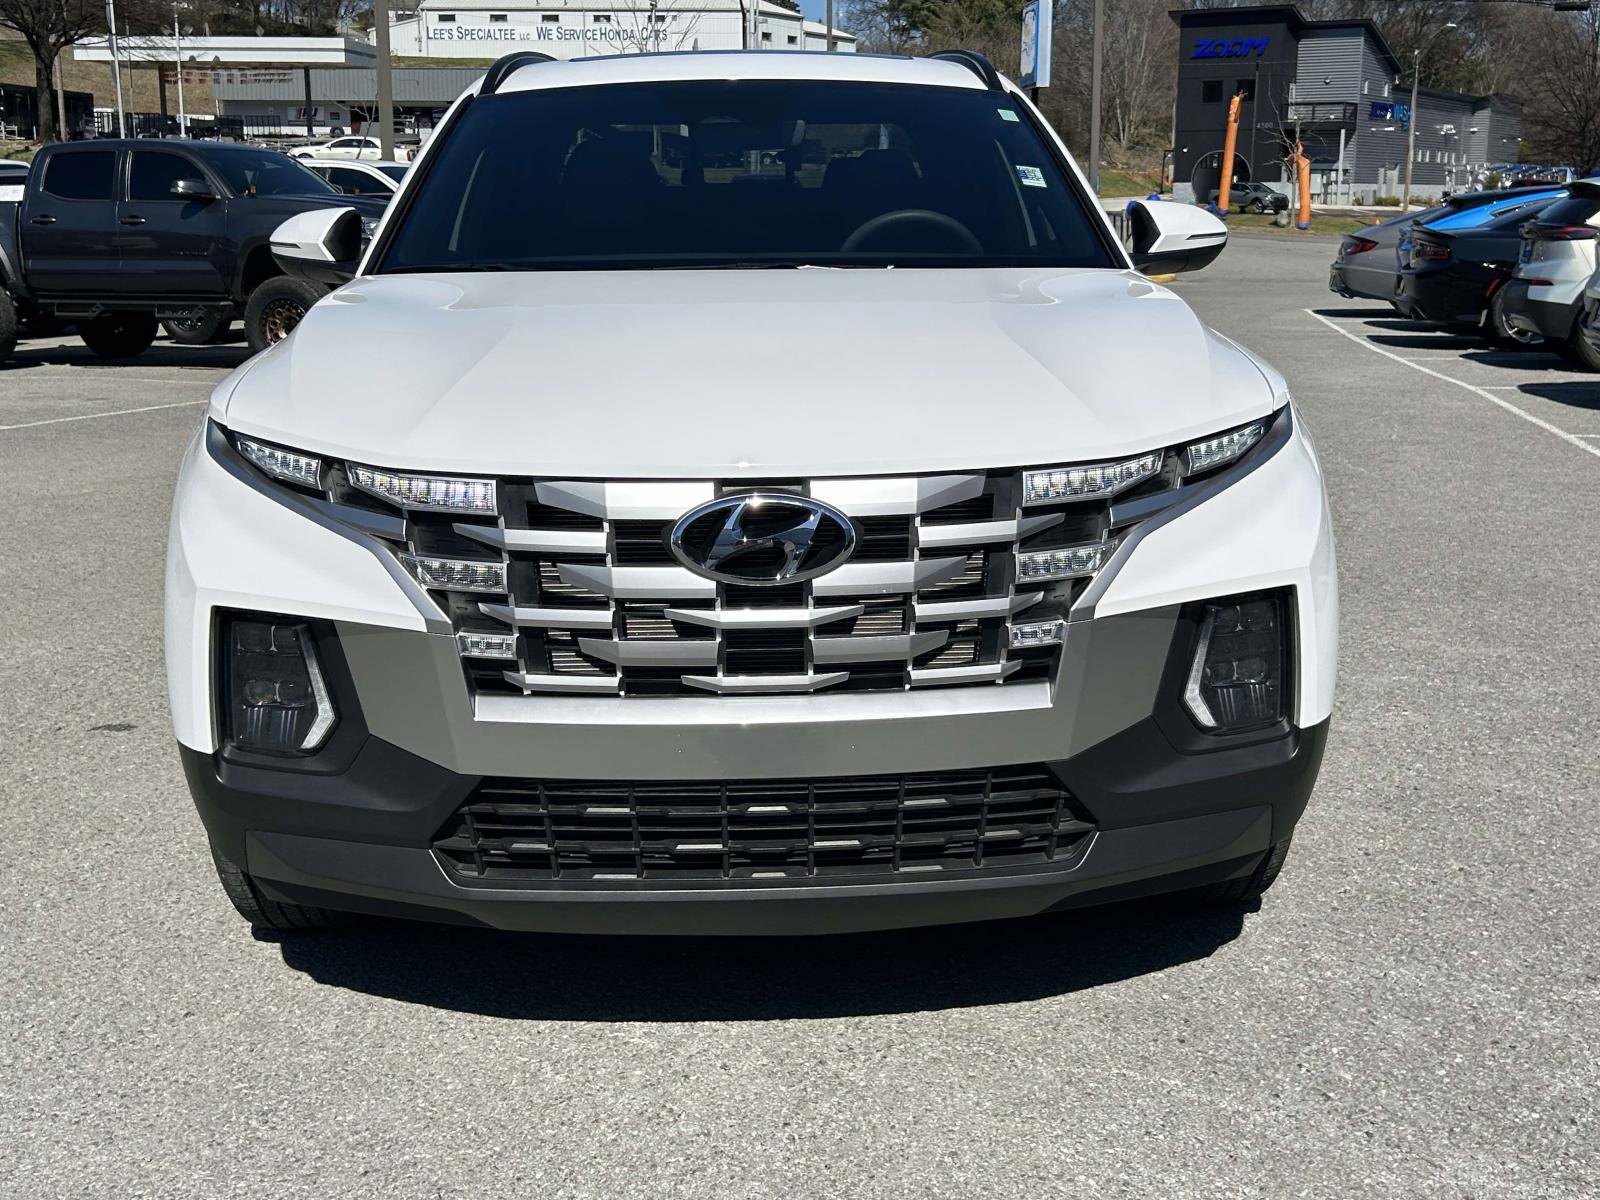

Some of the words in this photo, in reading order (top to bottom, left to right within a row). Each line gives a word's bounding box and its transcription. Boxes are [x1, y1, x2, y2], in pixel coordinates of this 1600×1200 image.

[427, 26, 454, 40] LEE'S
[456, 26, 516, 40] SPECIALTEE
[536, 26, 553, 40] WE
[556, 26, 598, 40] SERVICE
[599, 26, 635, 40] HONDA
[1191, 36, 1269, 59] ZOOM
